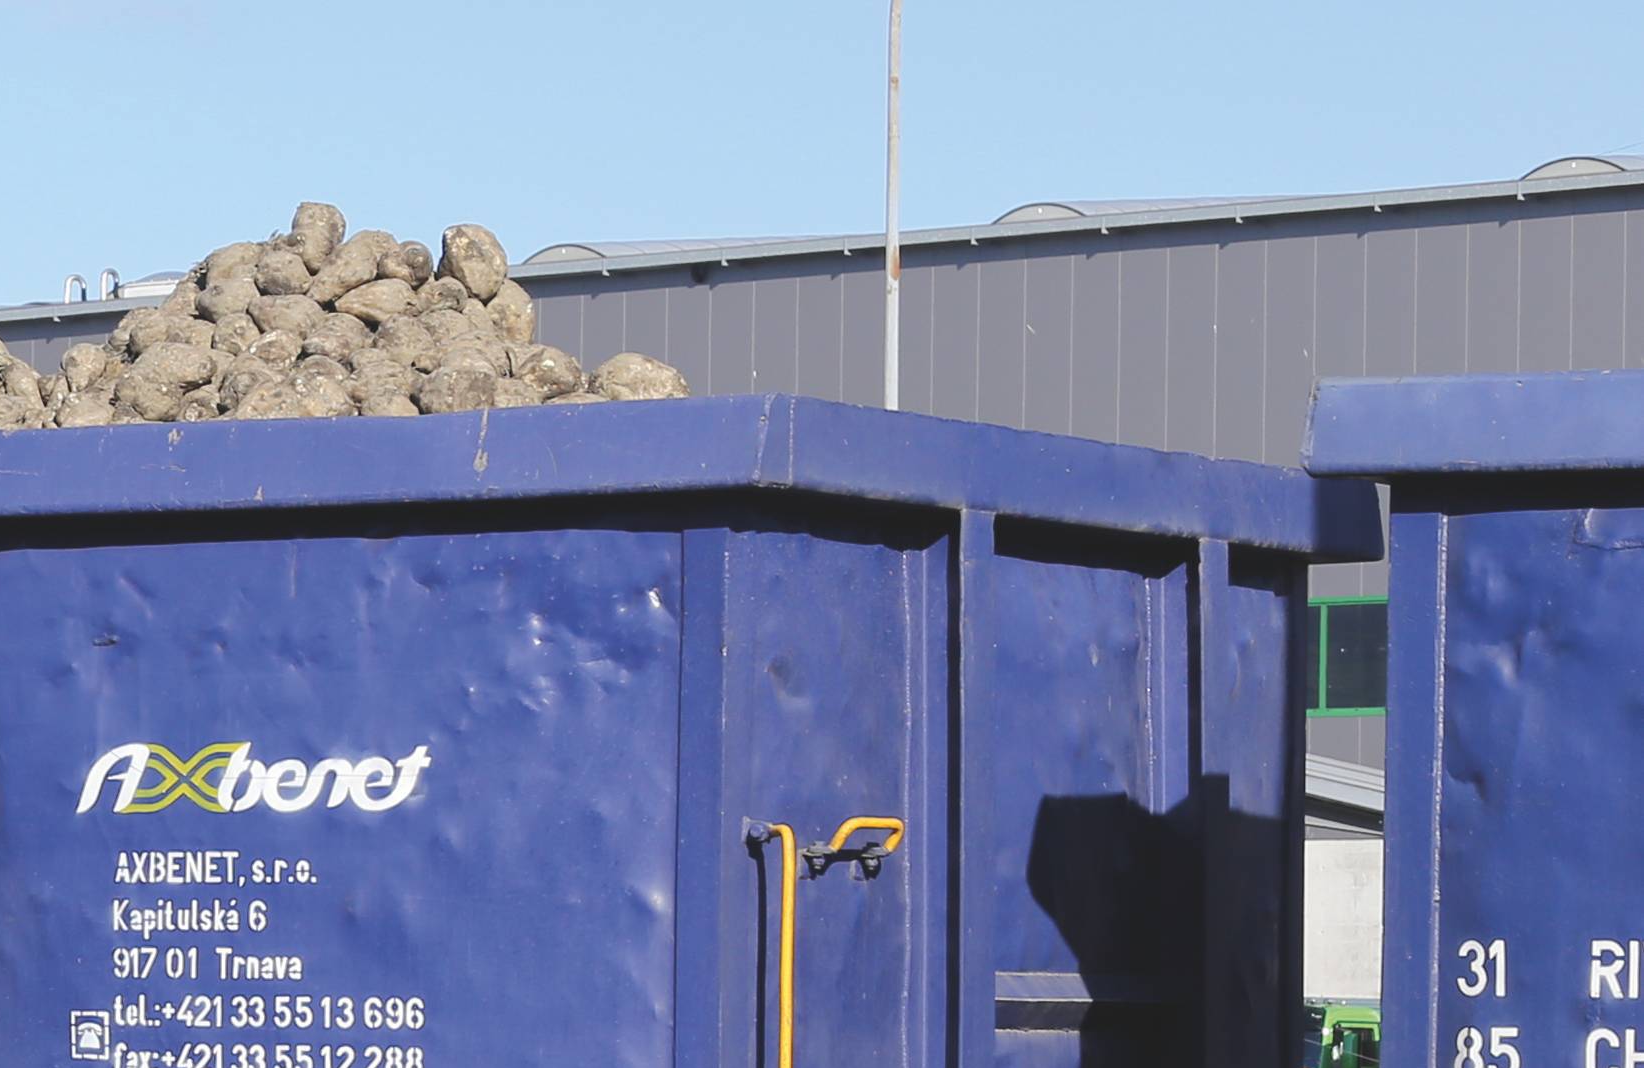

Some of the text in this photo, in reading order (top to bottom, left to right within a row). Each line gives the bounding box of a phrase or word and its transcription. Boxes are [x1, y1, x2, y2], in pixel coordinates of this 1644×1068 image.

[115, 851, 317, 887] AXBENET, s.r.o.
[113, 899, 267, 939] Kapitulská 6
[113, 948, 303, 981] 917 01 Trnava
[1457, 939, 1644, 999] 31 RI
[231, 996, 266, 1029] 33
[274, 997, 313, 1029] 55
[321, 997, 355, 1029] 13
[364, 997, 425, 1030] 696
